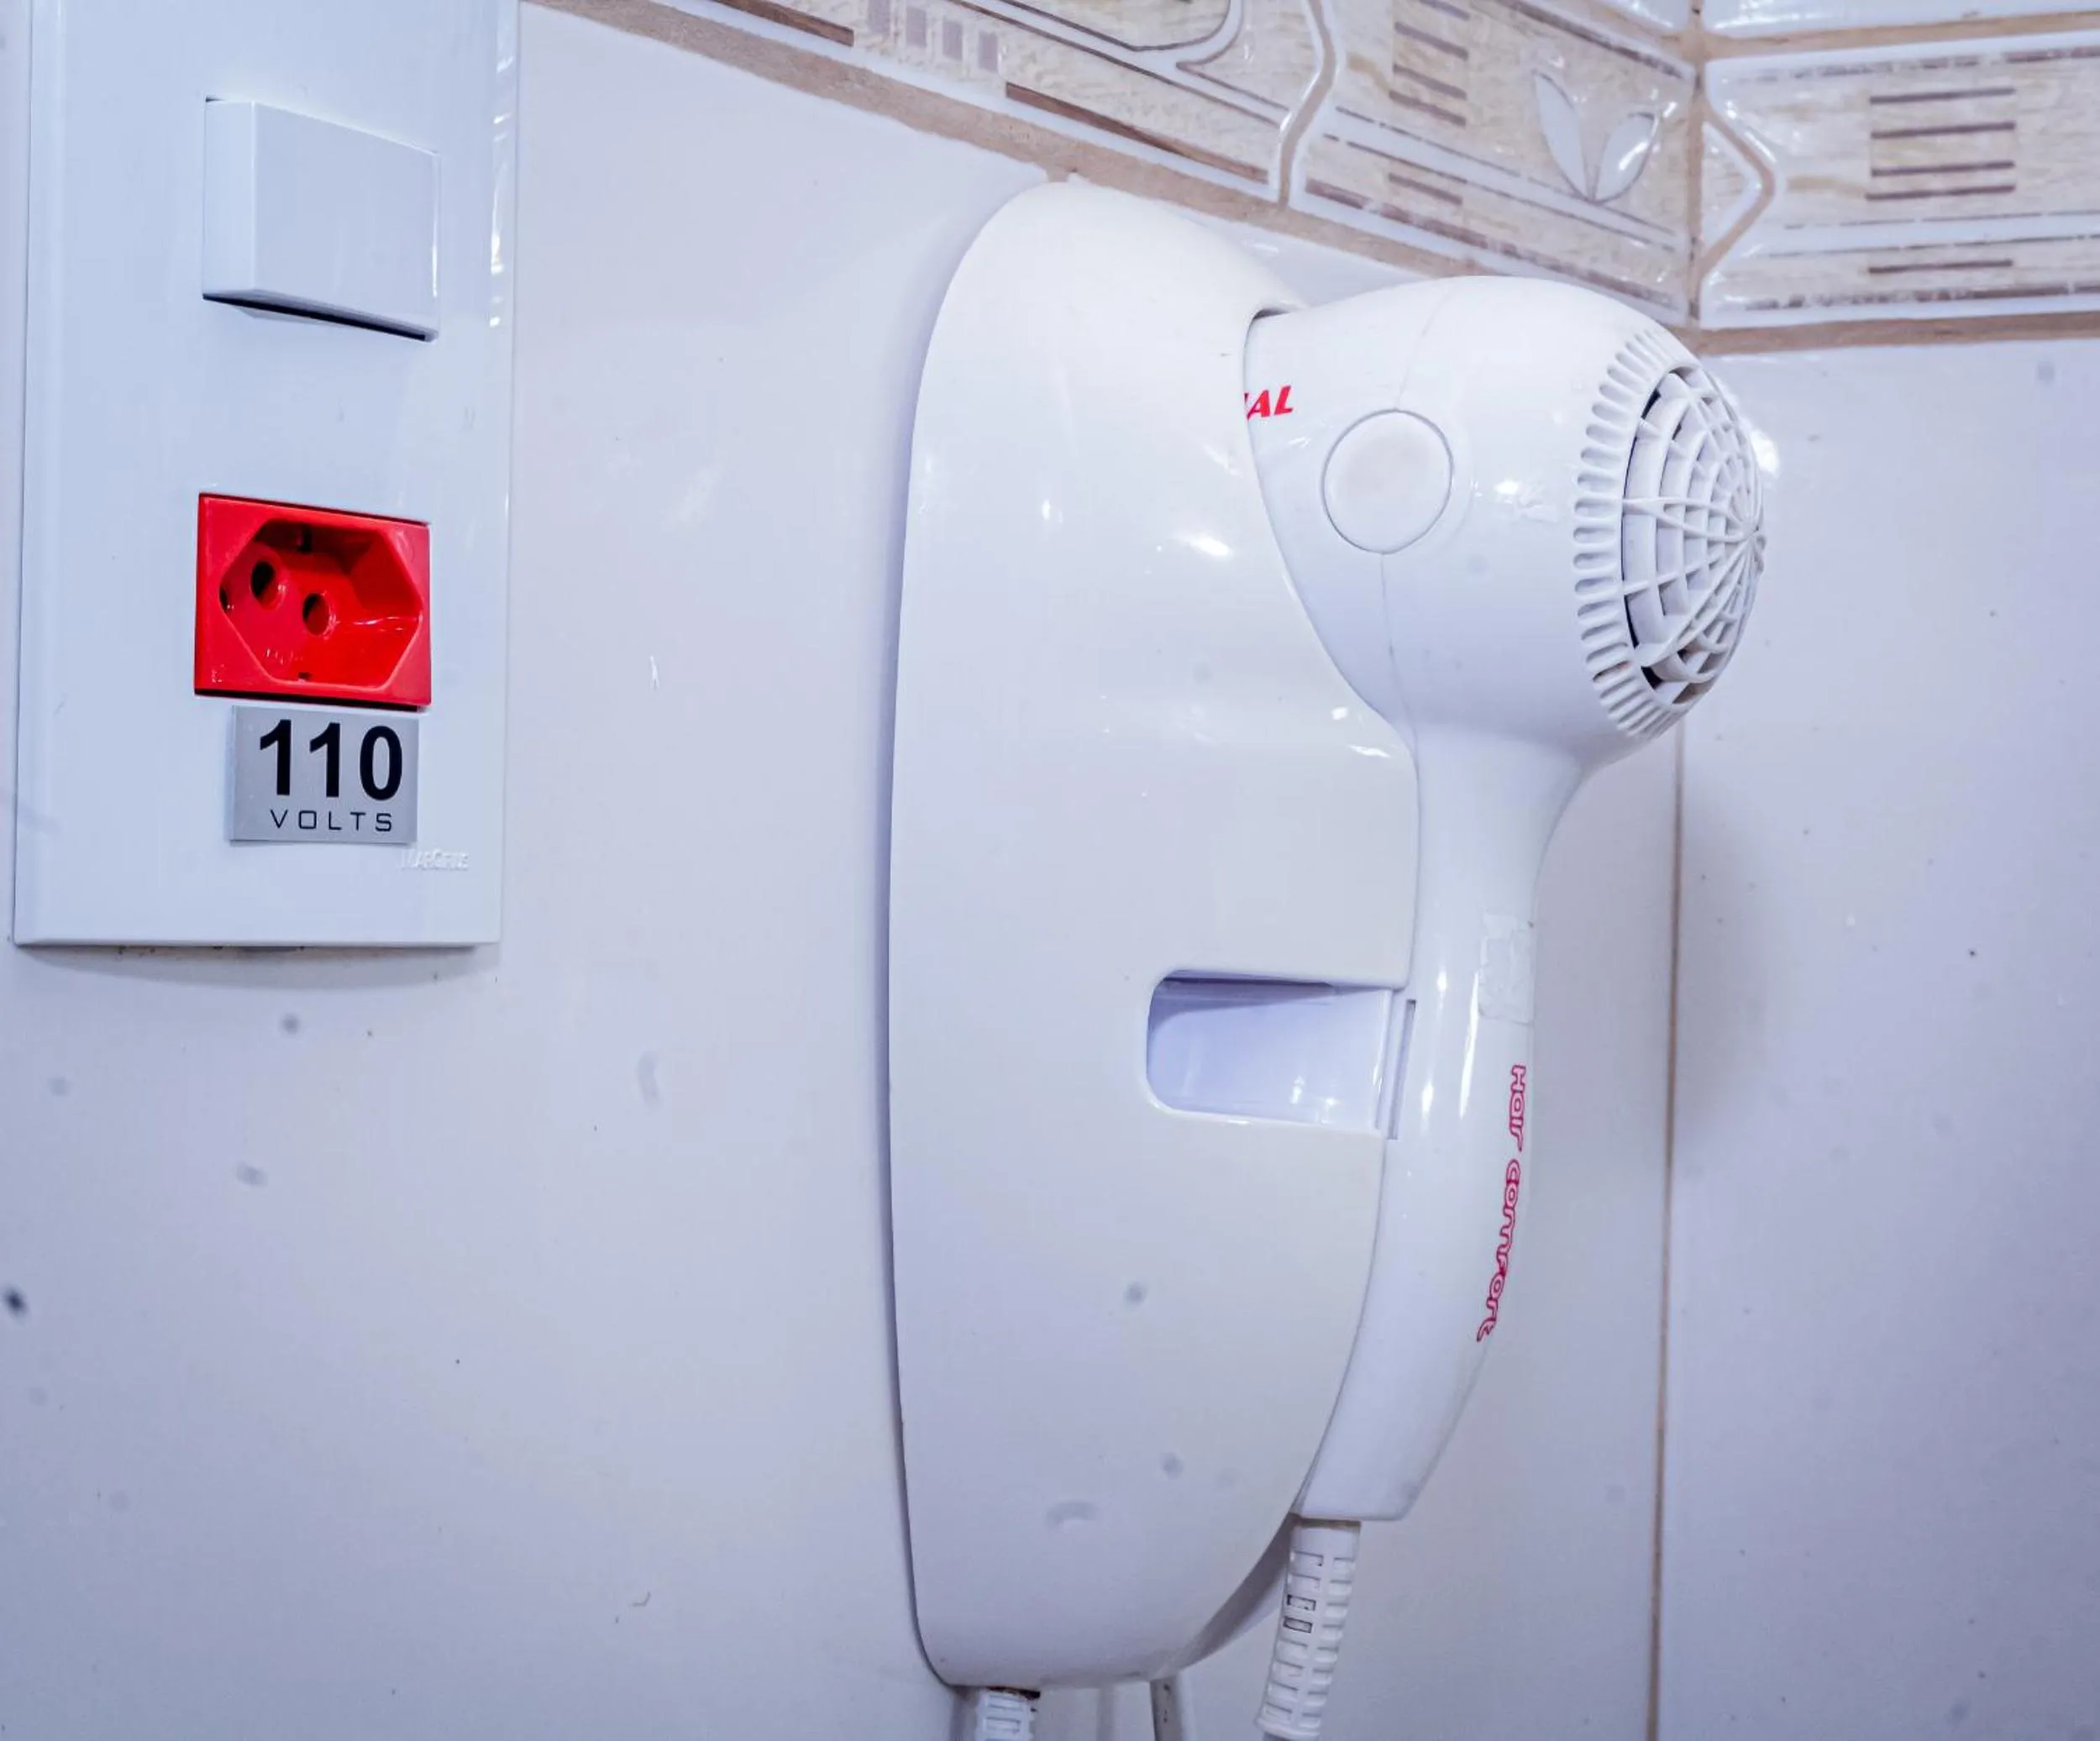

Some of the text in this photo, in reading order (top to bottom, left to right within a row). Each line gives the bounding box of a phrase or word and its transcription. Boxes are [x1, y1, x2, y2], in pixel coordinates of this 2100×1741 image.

[1244, 385, 1294, 420] AL
[260, 719, 402, 801] 110
[270, 809, 392, 832] VOLTS
[1509, 1065, 1526, 1151] Hair
